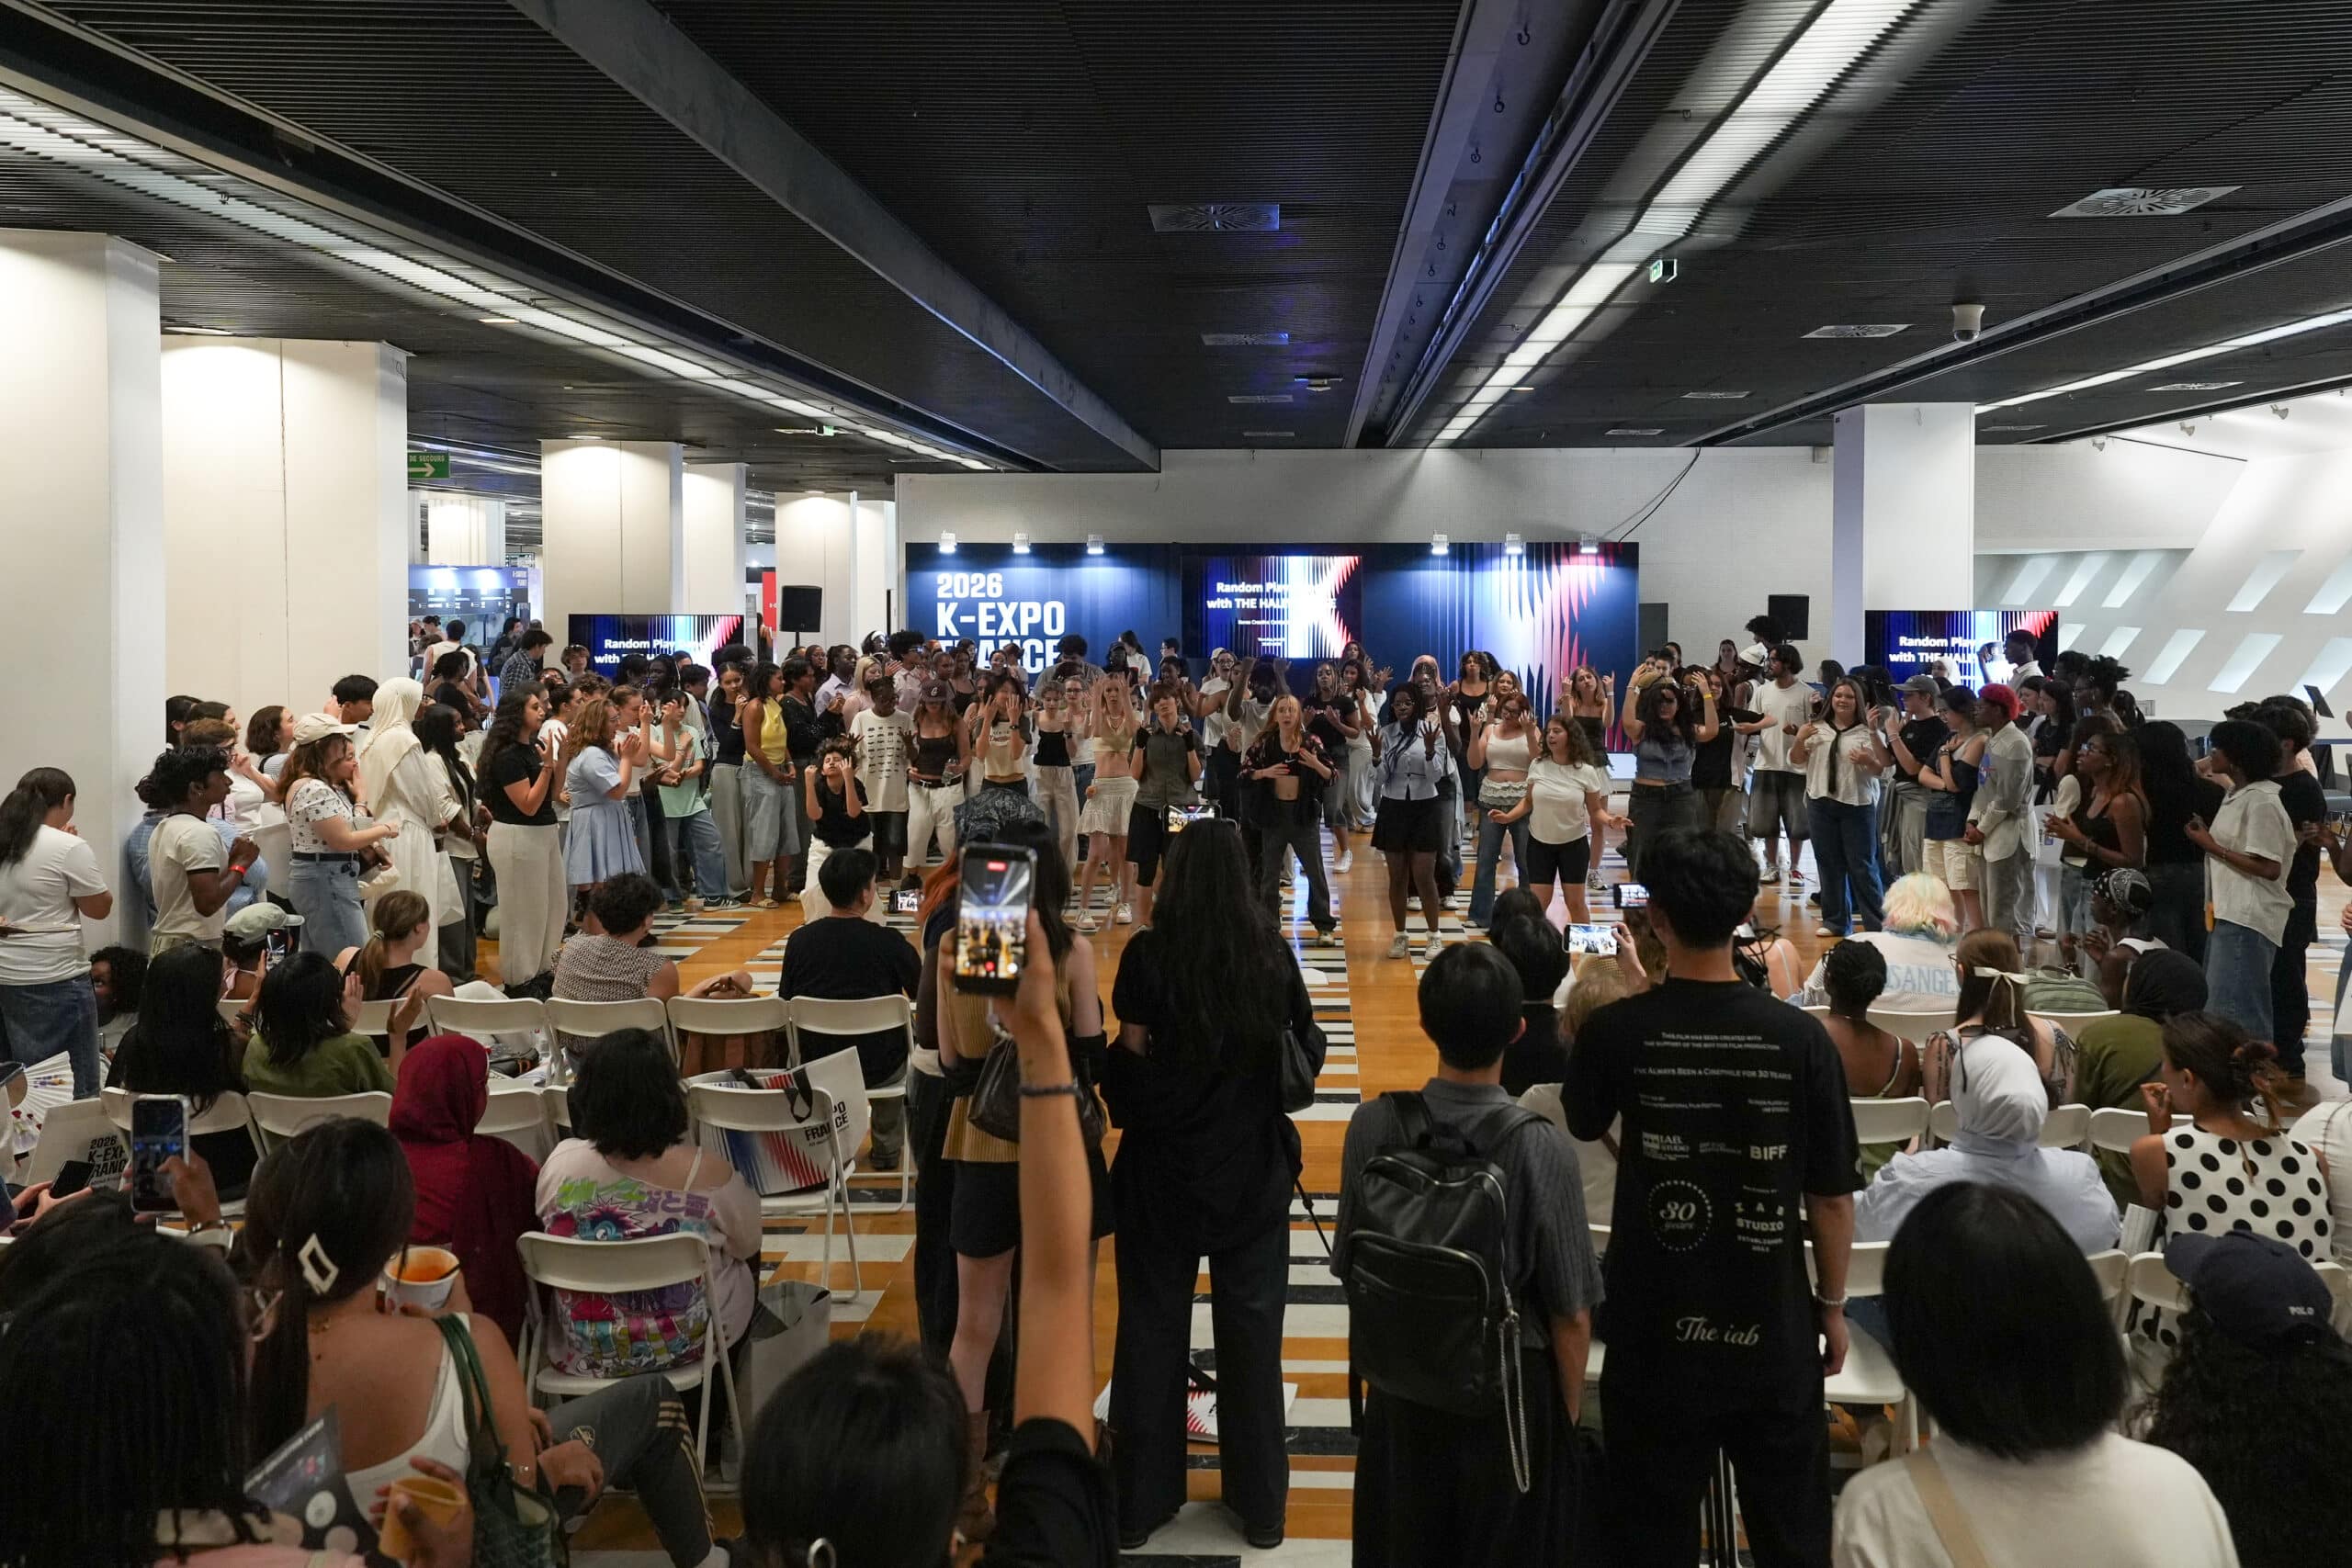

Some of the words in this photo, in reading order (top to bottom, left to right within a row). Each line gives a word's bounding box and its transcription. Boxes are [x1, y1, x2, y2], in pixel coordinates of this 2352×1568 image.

[937, 572, 1003, 598] 2026
[1216, 581, 1263, 593] Random
[1206, 598, 1232, 609] with
[1235, 598, 1257, 609] THE
[937, 600, 1066, 637] K-EXPO
[604, 638, 650, 649] Random
[653, 638, 676, 652] Play
[1899, 636, 1948, 648] Random
[594, 653, 620, 664] with
[1889, 650, 1915, 662] with
[90, 1135, 118, 1149] 2026
[87, 1145, 126, 1163] K-EXP
[1749, 1145, 1788, 1161] BIFF
[94, 1158, 128, 1177] RANC
[1736, 1217, 1784, 1232] STUDIO
[1676, 1315, 1719, 1342] The
[1724, 1323, 1761, 1347] iab
